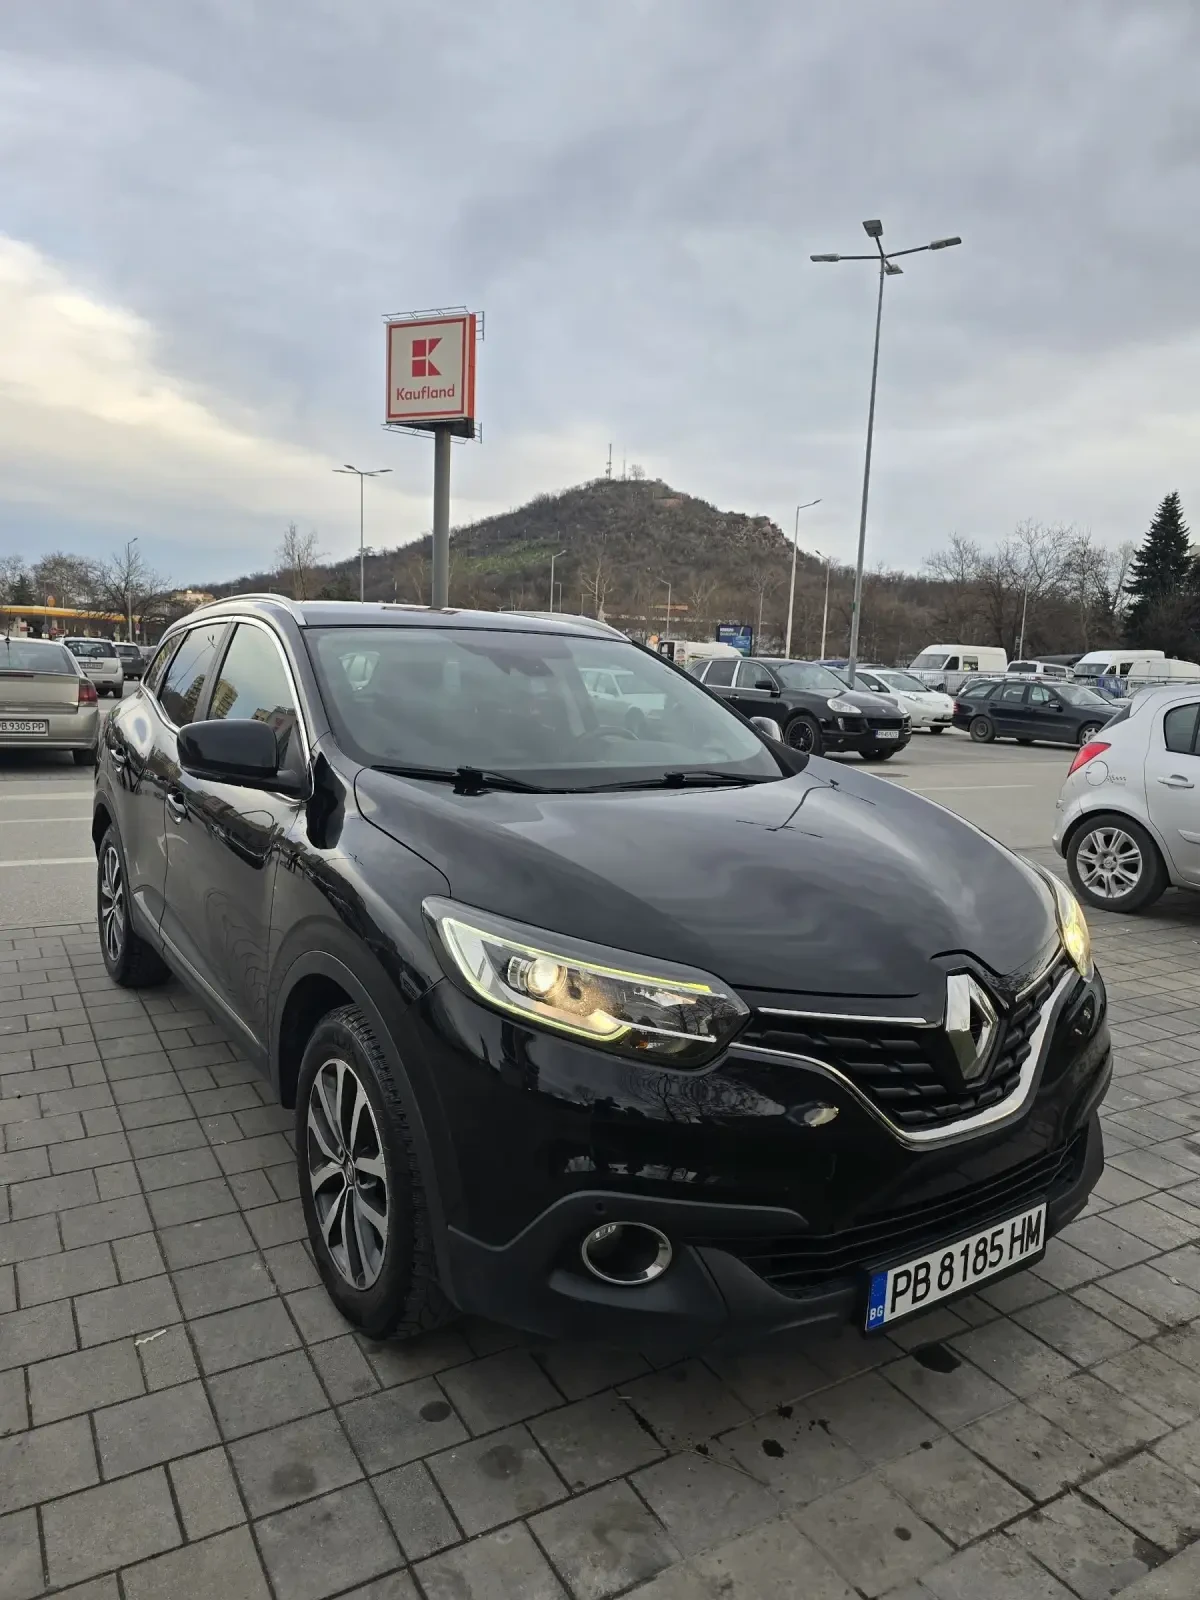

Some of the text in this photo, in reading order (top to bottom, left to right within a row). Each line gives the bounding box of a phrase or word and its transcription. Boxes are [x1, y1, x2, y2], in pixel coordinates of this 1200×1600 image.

[396, 383, 455, 401] Kaufland
[0, 722, 44, 731] B 9305 PP
[889, 1209, 1042, 1314] PB 8185 HM
[869, 1305, 884, 1321] BG
